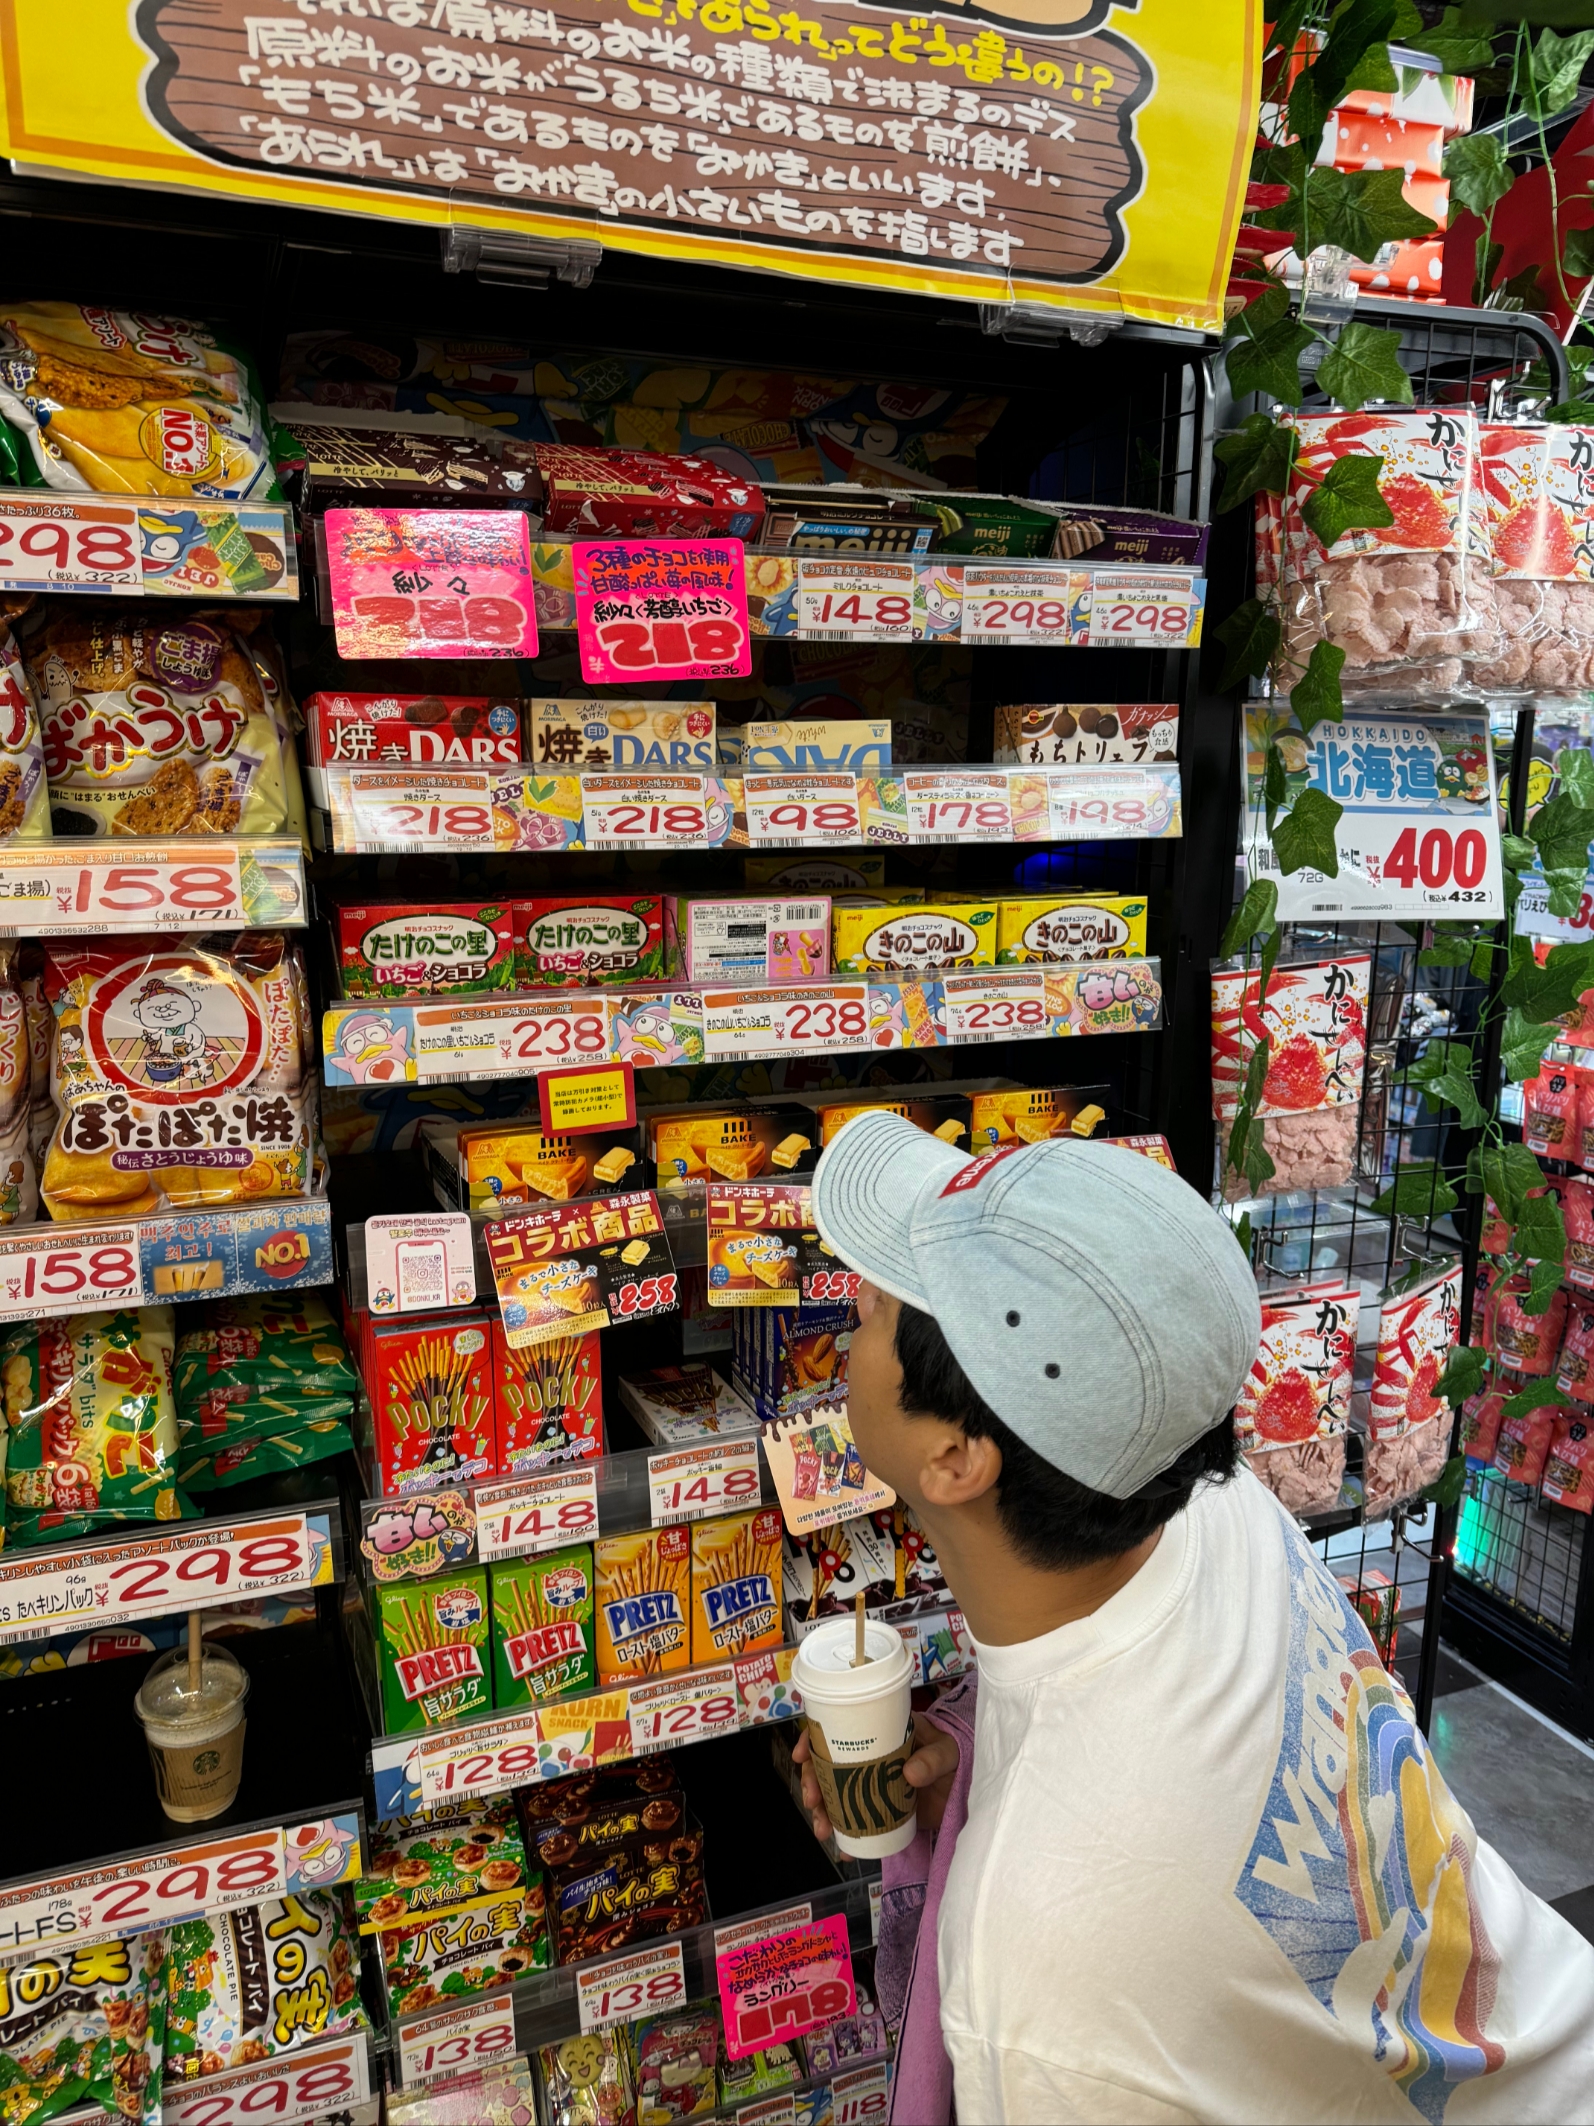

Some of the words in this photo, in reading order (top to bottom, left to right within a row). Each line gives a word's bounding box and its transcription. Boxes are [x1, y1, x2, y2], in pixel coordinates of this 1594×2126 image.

[973, 525, 1011, 542] meiji
[1115, 538, 1149, 554] meiji
[821, 594, 911, 625] 148
[981, 601, 1066, 629] 298
[1109, 605, 1188, 633] 298
[598, 619, 742, 668] 218
[409, 730, 518, 762] DARS
[1323, 724, 1426, 742] HOKKAIDO
[612, 735, 713, 764] DARS
[1306, 741, 1441, 800] 北海道
[606, 805, 705, 833] 218
[769, 803, 859, 831] 98
[927, 802, 1010, 829] 178
[1068, 799, 1146, 826] 198
[1383, 827, 1487, 889] 400
[75, 867, 237, 912] 158
[344, 911, 367, 921] meiji
[513, 902, 532, 911] meiji
[846, 914, 864, 922] meiji
[1006, 905, 1023, 913] meiji
[369, 929, 490, 960] たけのこの里
[535, 920, 643, 949] たけのこの里
[879, 928, 964, 957] きのこの山
[1036, 917, 1118, 947] きのこの山
[373, 961, 488, 987] いちご&ショコラ
[538, 952, 639, 972] いちご&ショコラ
[785, 1001, 868, 1040] 238
[965, 1000, 1044, 1030] 238
[513, 1016, 606, 1058] 238
[63, 1095, 295, 1151] ぽたぽた焼
[1028, 1104, 1059, 1115] BAKE
[537, 1148, 576, 1160] BAKE
[720, 1133, 757, 1145] BAKE
[609, 1192, 651, 1209] 森永製菓
[492, 1204, 659, 1265] コラボ商品
[727, 1236, 782, 1253] まるで小さな
[746, 1246, 798, 1263] チーズケーキ
[24, 1248, 136, 1298] 158
[519, 1260, 579, 1289] まるで小さな
[542, 1266, 597, 1295] チーズケーキ
[620, 1274, 677, 1315] 258
[783, 1326, 823, 1339] ALMOND
[825, 1320, 854, 1331] CRUSH
[502, 1367, 598, 1421] POCKY
[386, 1387, 489, 1440] POCKY
[531, 1413, 570, 1425] CHOCOLATE
[418, 1433, 460, 1446] CHOCOLATE
[672, 1469, 758, 1508] 148
[502, 1501, 596, 1542] 148
[110, 1537, 303, 1602] 298
[18, 1588, 93, 1621] たべキリンパック
[707, 1577, 771, 1623] PRETZ
[608, 1594, 678, 1637] PRETZ
[511, 1625, 580, 1674] PRETZ
[736, 1654, 771, 1673] POTATO
[400, 1646, 476, 1693] PRETZ
[529, 1657, 584, 1695] 旨サラダ
[738, 1662, 773, 1683] CHIPS
[425, 1678, 482, 1718] 旨サラダ
[652, 1696, 736, 1737] 128
[831, 1738, 876, 1746] STARBUCKS
[445, 1745, 538, 1789] 128
[579, 1814, 639, 1844] パイの実
[93, 1850, 279, 1924] 298
[410, 1876, 478, 1908] パイの実
[586, 1864, 679, 1922] パイの実
[413, 1902, 522, 1962] パイの実
[729, 1937, 796, 1972] こだわりの
[601, 1973, 683, 2016] 138
[744, 1980, 809, 2007] ラングリー
[425, 2025, 514, 2071] 138
